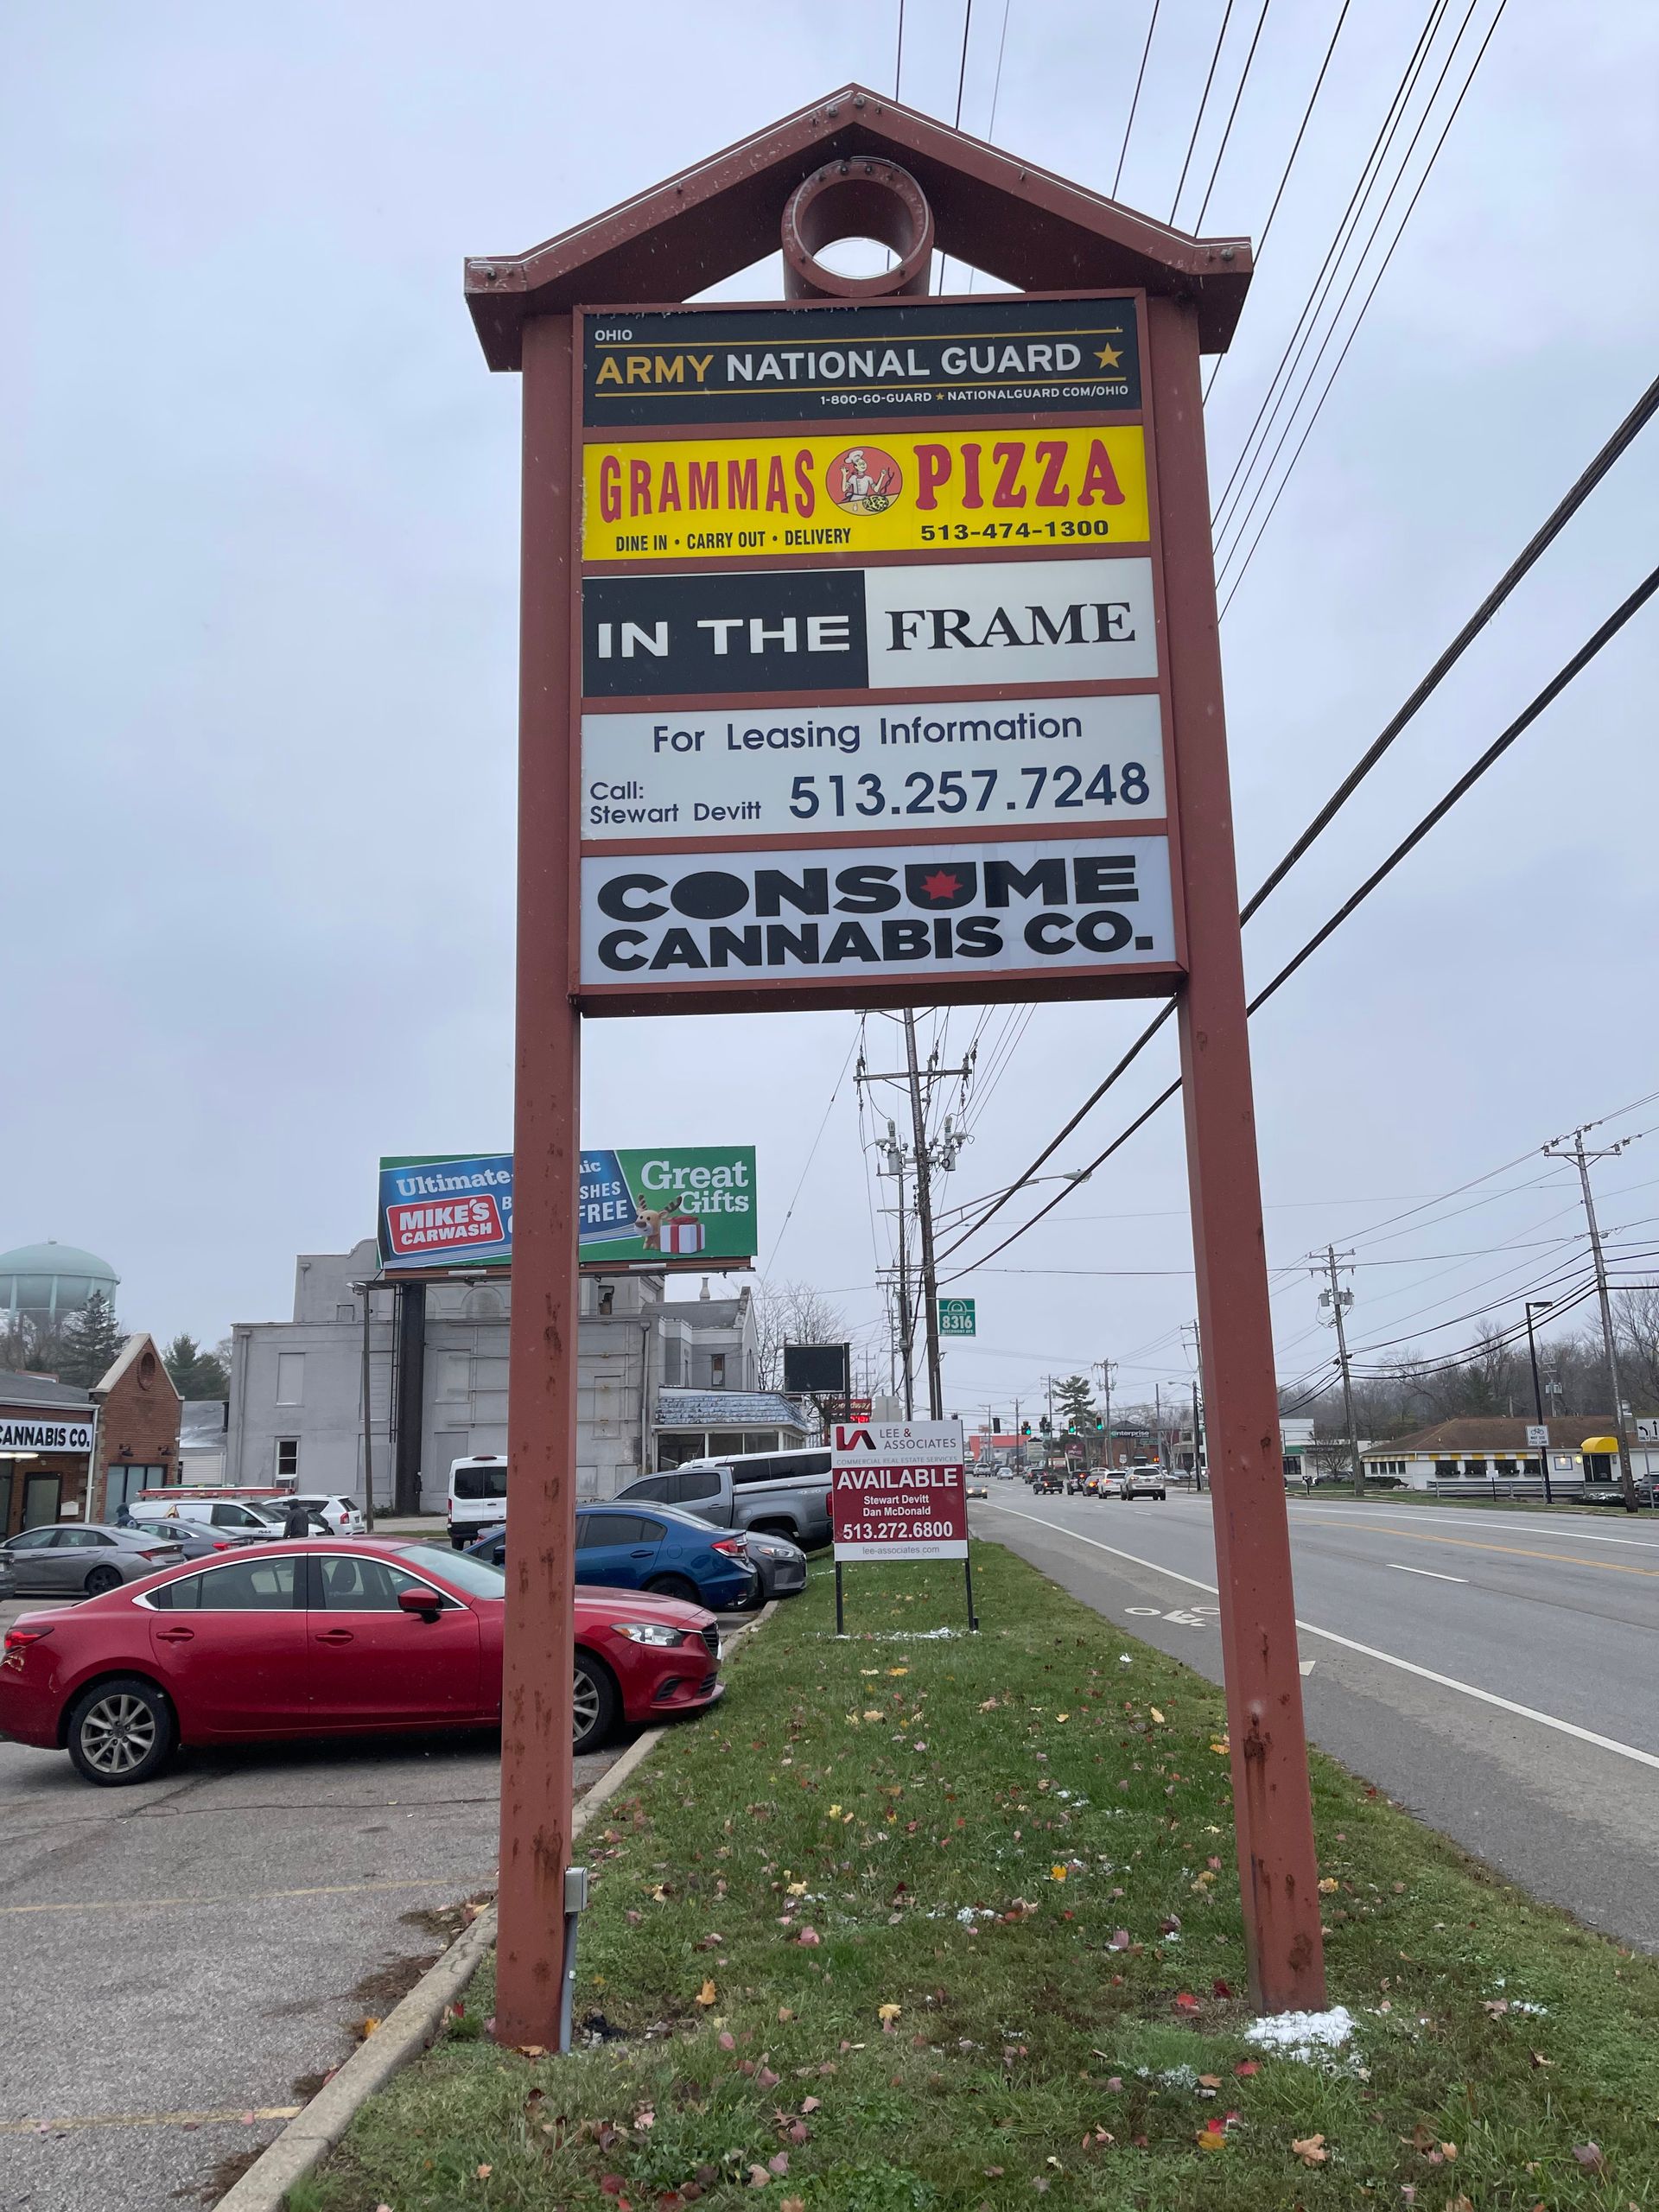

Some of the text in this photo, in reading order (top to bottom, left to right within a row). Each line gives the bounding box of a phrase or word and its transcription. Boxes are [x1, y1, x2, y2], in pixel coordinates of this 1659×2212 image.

[594, 329, 632, 341] OHIO
[595, 344, 1082, 385] ARMY NATIONAL GUARD
[820, 391, 932, 404] 1-800-GO-GUARD
[601, 439, 1125, 523] GRAMMAS PIZZA
[615, 527, 851, 552] DINE IN CARRY OUT DELIVERY
[920, 519, 1109, 541] 513-474-1300
[598, 601, 1136, 658] IN THE FRAME
[653, 713, 1083, 754] For Leasing Information
[589, 780, 644, 801] Call:
[589, 761, 1150, 825] Stewart Devitt 513.257.7248
[597, 855, 1140, 922] CONSUME
[598, 910, 1154, 971] CANNABIS CO.
[640, 1160, 749, 1190] Great
[678, 1190, 750, 1214] Gifts
[399, 1198, 490, 1231] MIKE'S
[401, 1222, 493, 1245] CARWASH
[942, 1314, 973, 1329] 8316
[69, 1427, 90, 1447] CO.
[880, 1427, 912, 1439] LEE &
[884, 1439, 957, 1450] ASSOCIATES
[836, 1467, 958, 1490] AVAILABLE
[863, 1494, 930, 1505] Stewart Devitt
[862, 1506, 931, 1517] Dan McDonald
[842, 1521, 953, 1540] 513.272.6800
[862, 1546, 940, 1555] lee-associates.com
